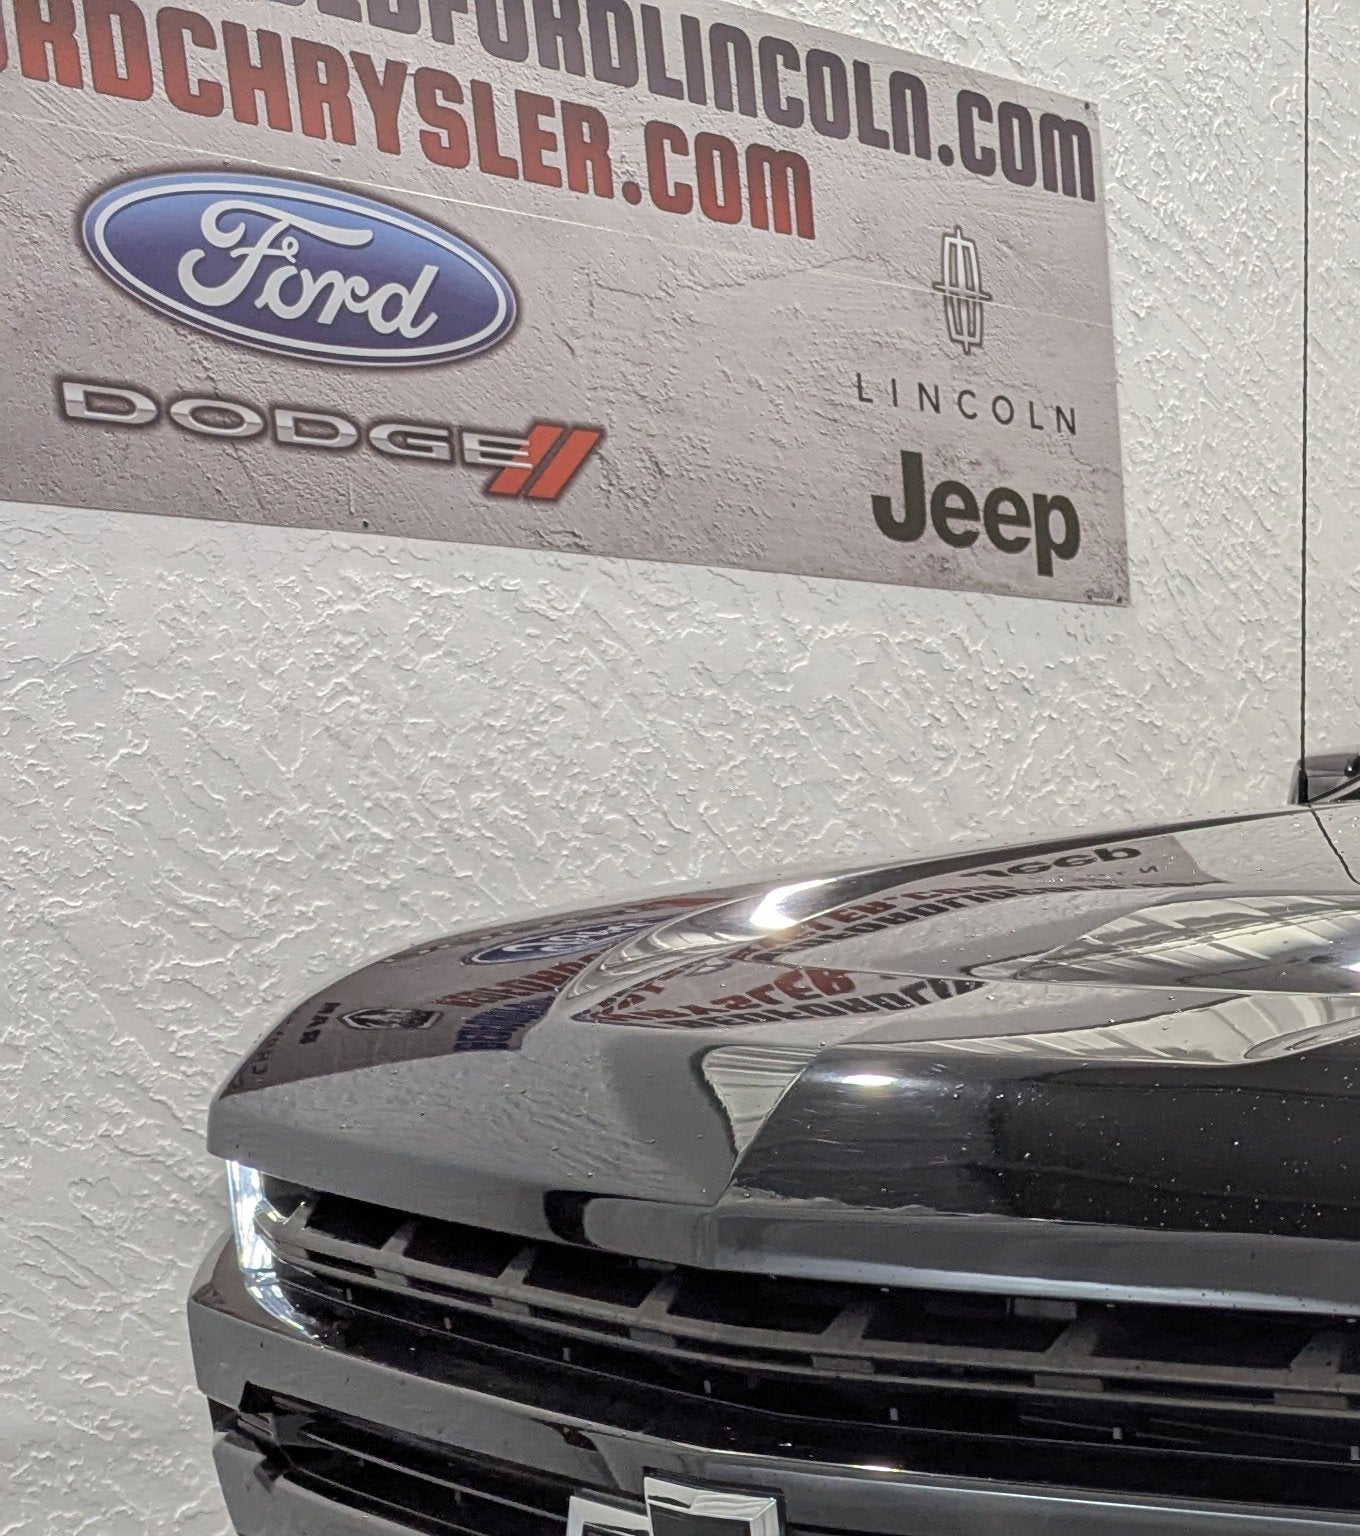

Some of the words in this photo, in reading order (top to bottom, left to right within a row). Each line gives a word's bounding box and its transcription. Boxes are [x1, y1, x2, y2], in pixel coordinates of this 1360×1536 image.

[0, 0, 816, 240] RDCHRYSLER.COM
[178, 199, 440, 339] Ford
[61, 381, 534, 469] DODGE
[856, 372, 1077, 435] LINCOLN
[871, 449, 1081, 577] Jeep
